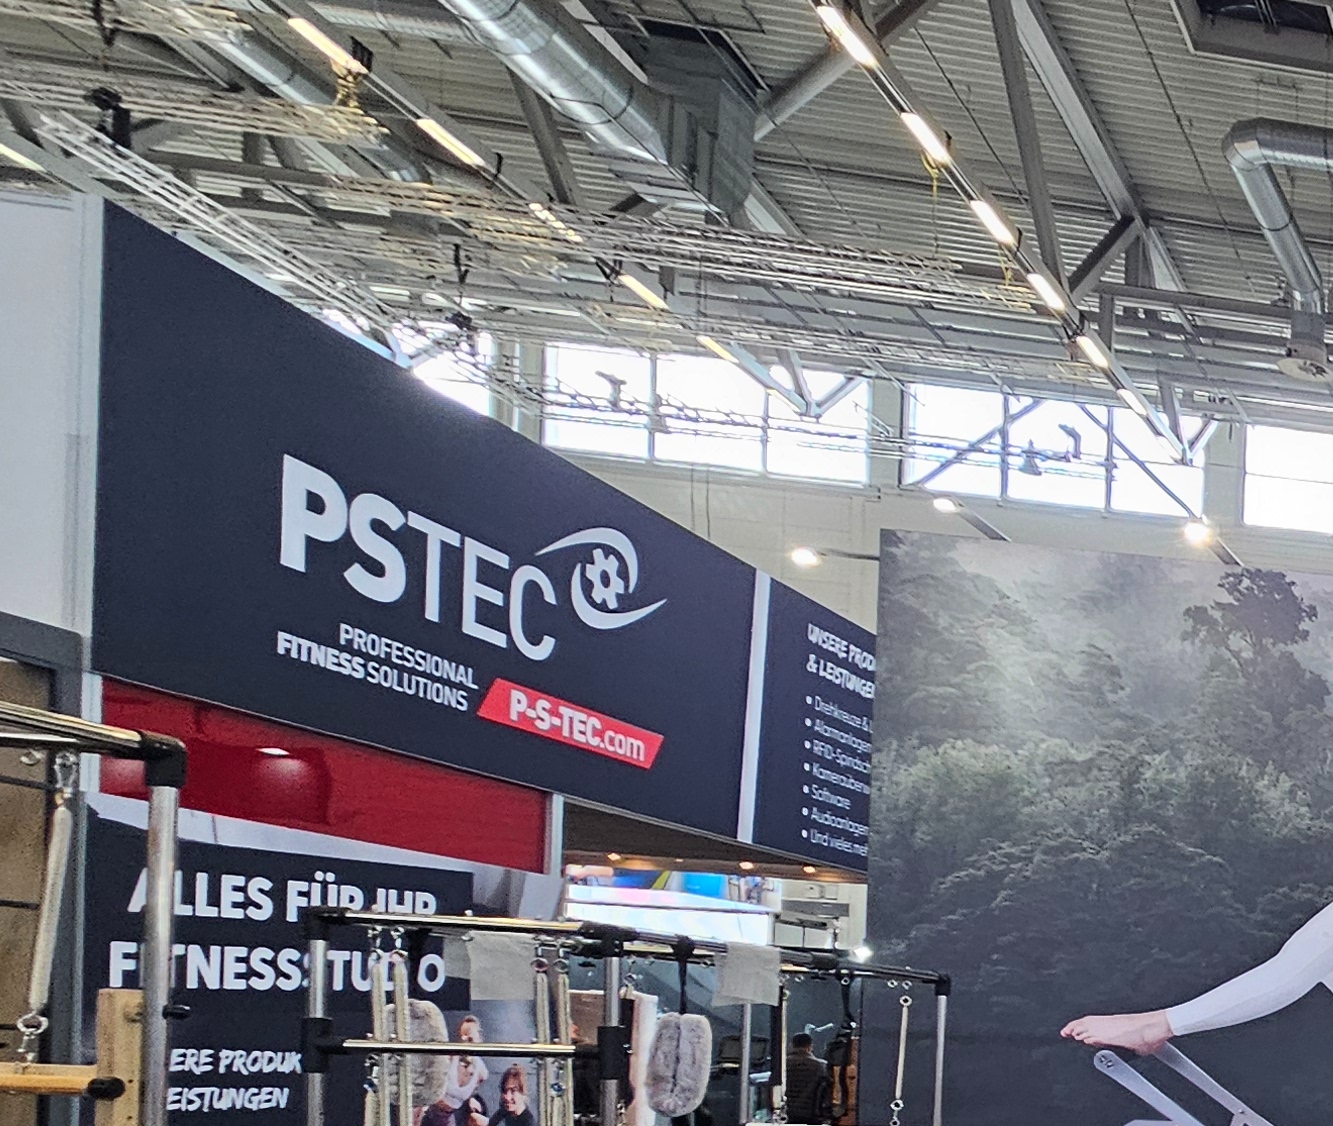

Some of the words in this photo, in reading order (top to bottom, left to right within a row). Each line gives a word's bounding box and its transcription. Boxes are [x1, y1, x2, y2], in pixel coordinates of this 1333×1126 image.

[280, 454, 557, 661] PSTEC
[277, 631, 367, 680] FITNESS
[366, 661, 469, 712] SOLUTIONS
[339, 623, 479, 690] PROFESSIONAL
[806, 654, 818, 673] &
[819, 659, 875, 699] LEISTUNGE
[848, 644, 876, 671] PROD
[509, 689, 645, 762] P-S-TEC.com
[168, 1049, 215, 1075] ERE
[219, 1049, 304, 1075] PRODUK
[166, 1086, 290, 1112] EISTUNGEN
